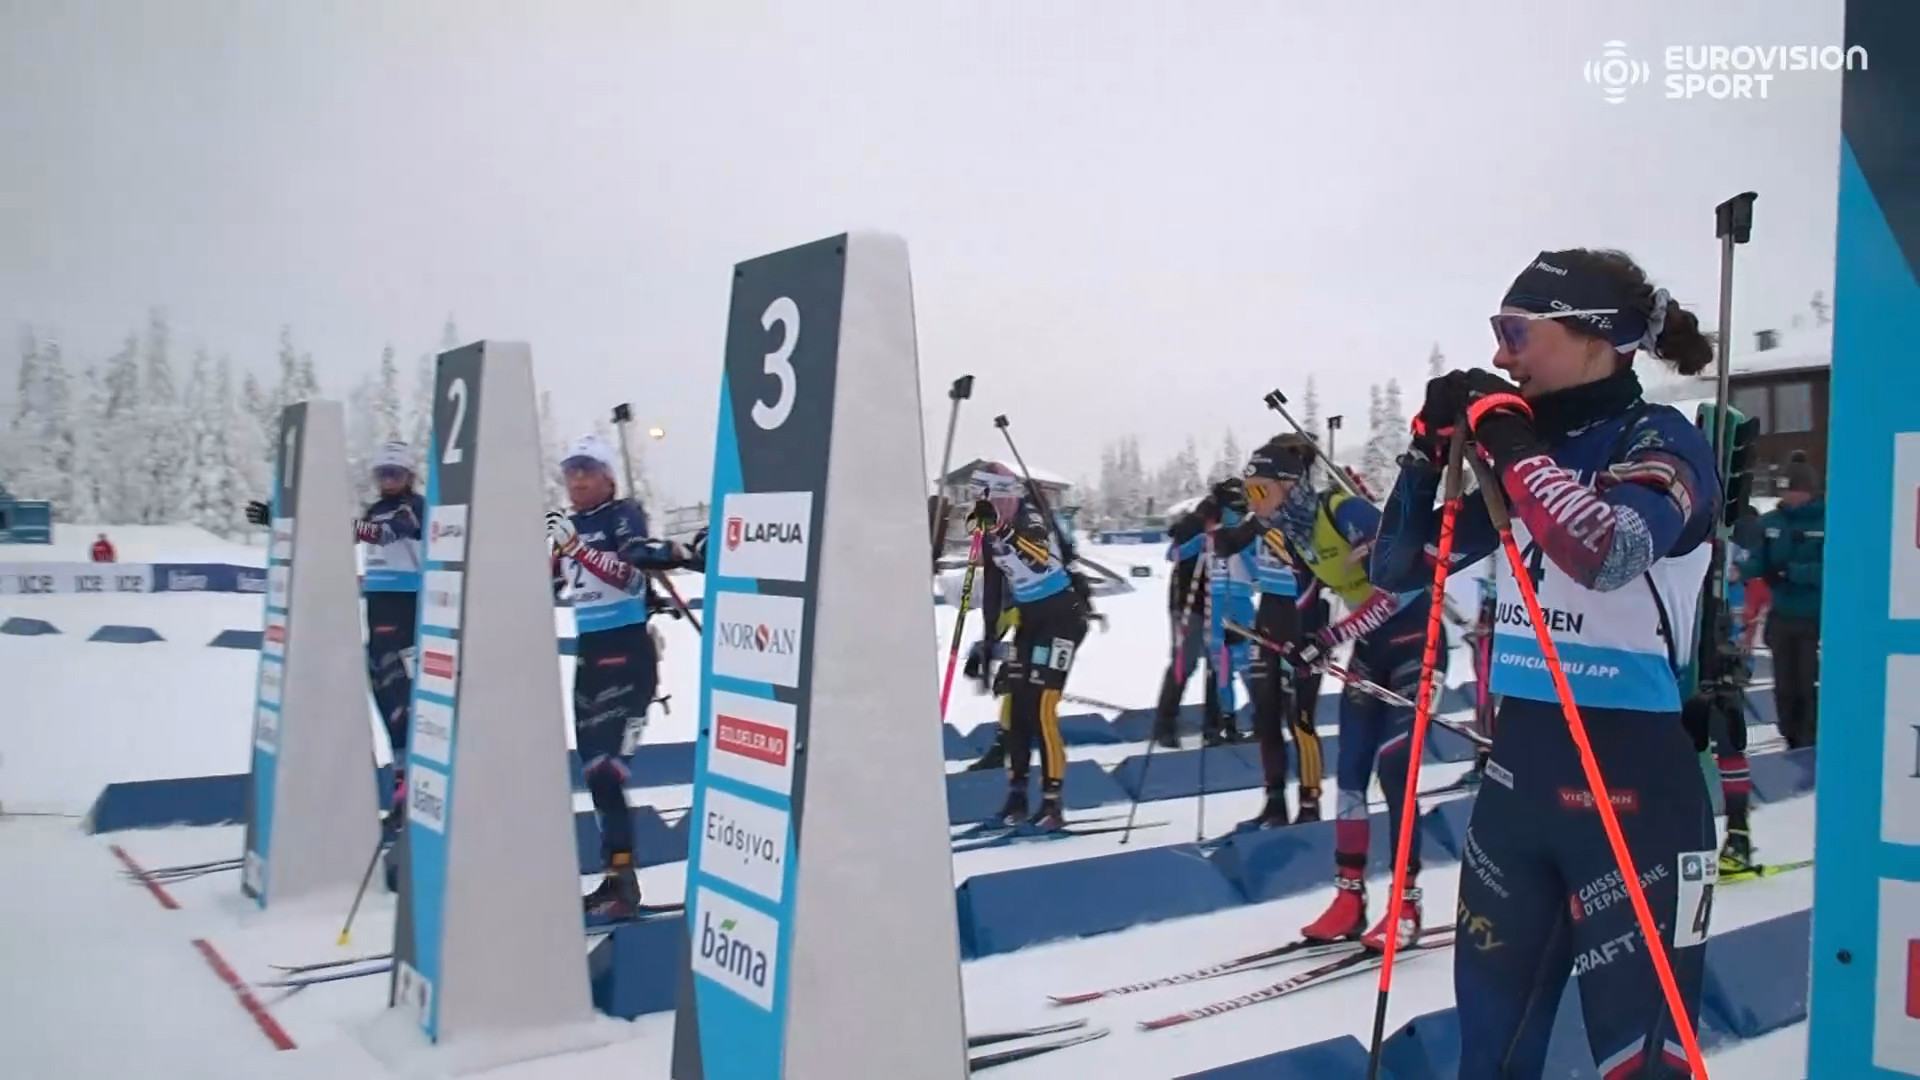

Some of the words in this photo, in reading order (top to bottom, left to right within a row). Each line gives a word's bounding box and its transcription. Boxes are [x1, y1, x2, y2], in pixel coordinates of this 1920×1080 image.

[751, 297, 800, 430] 3
[442, 377, 468, 464] 2
[283, 424, 297, 488] 1
[1513, 455, 1616, 553] FRANCE
[744, 523, 803, 544] LAPUA
[569, 560, 586, 589] 2
[1512, 541, 1546, 595] 4
[1494, 603, 1584, 634] JUSØEN
[718, 622, 796, 655] NORSAN
[1057, 650, 1068, 668] 6
[1500, 653, 1550, 671] OFFICIA
[1586, 665, 1619, 678] APP
[719, 724, 784, 756] BILDELER.NO
[1562, 791, 1632, 807] VIESSNN
[1579, 869, 1624, 900] CAISSE
